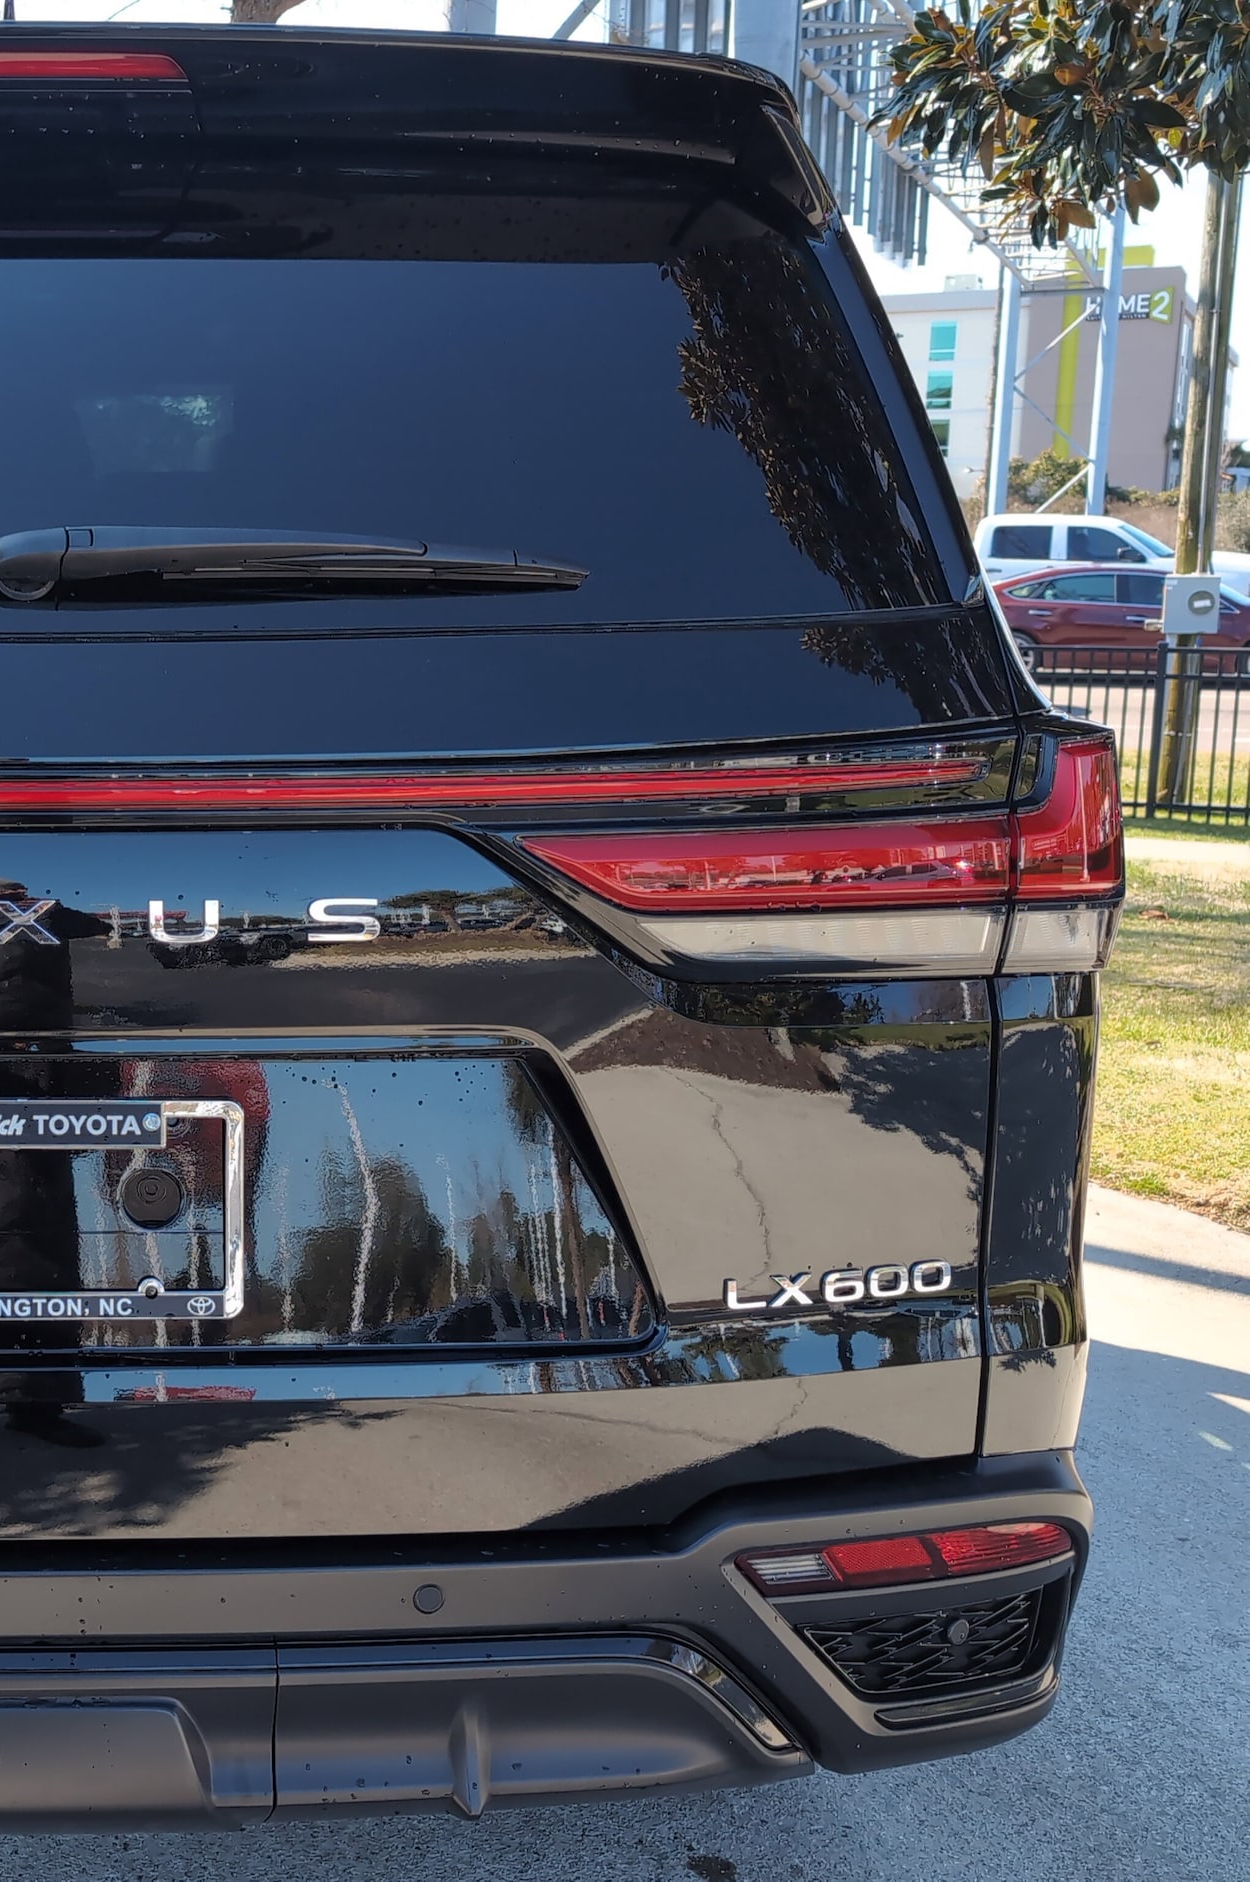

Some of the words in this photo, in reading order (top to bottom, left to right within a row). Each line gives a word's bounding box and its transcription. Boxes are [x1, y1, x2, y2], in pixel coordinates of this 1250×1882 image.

[1085, 290, 1171, 320] HME2
[33, 1114, 141, 1135] TOYOTA
[99, 1298, 133, 1316] NC
